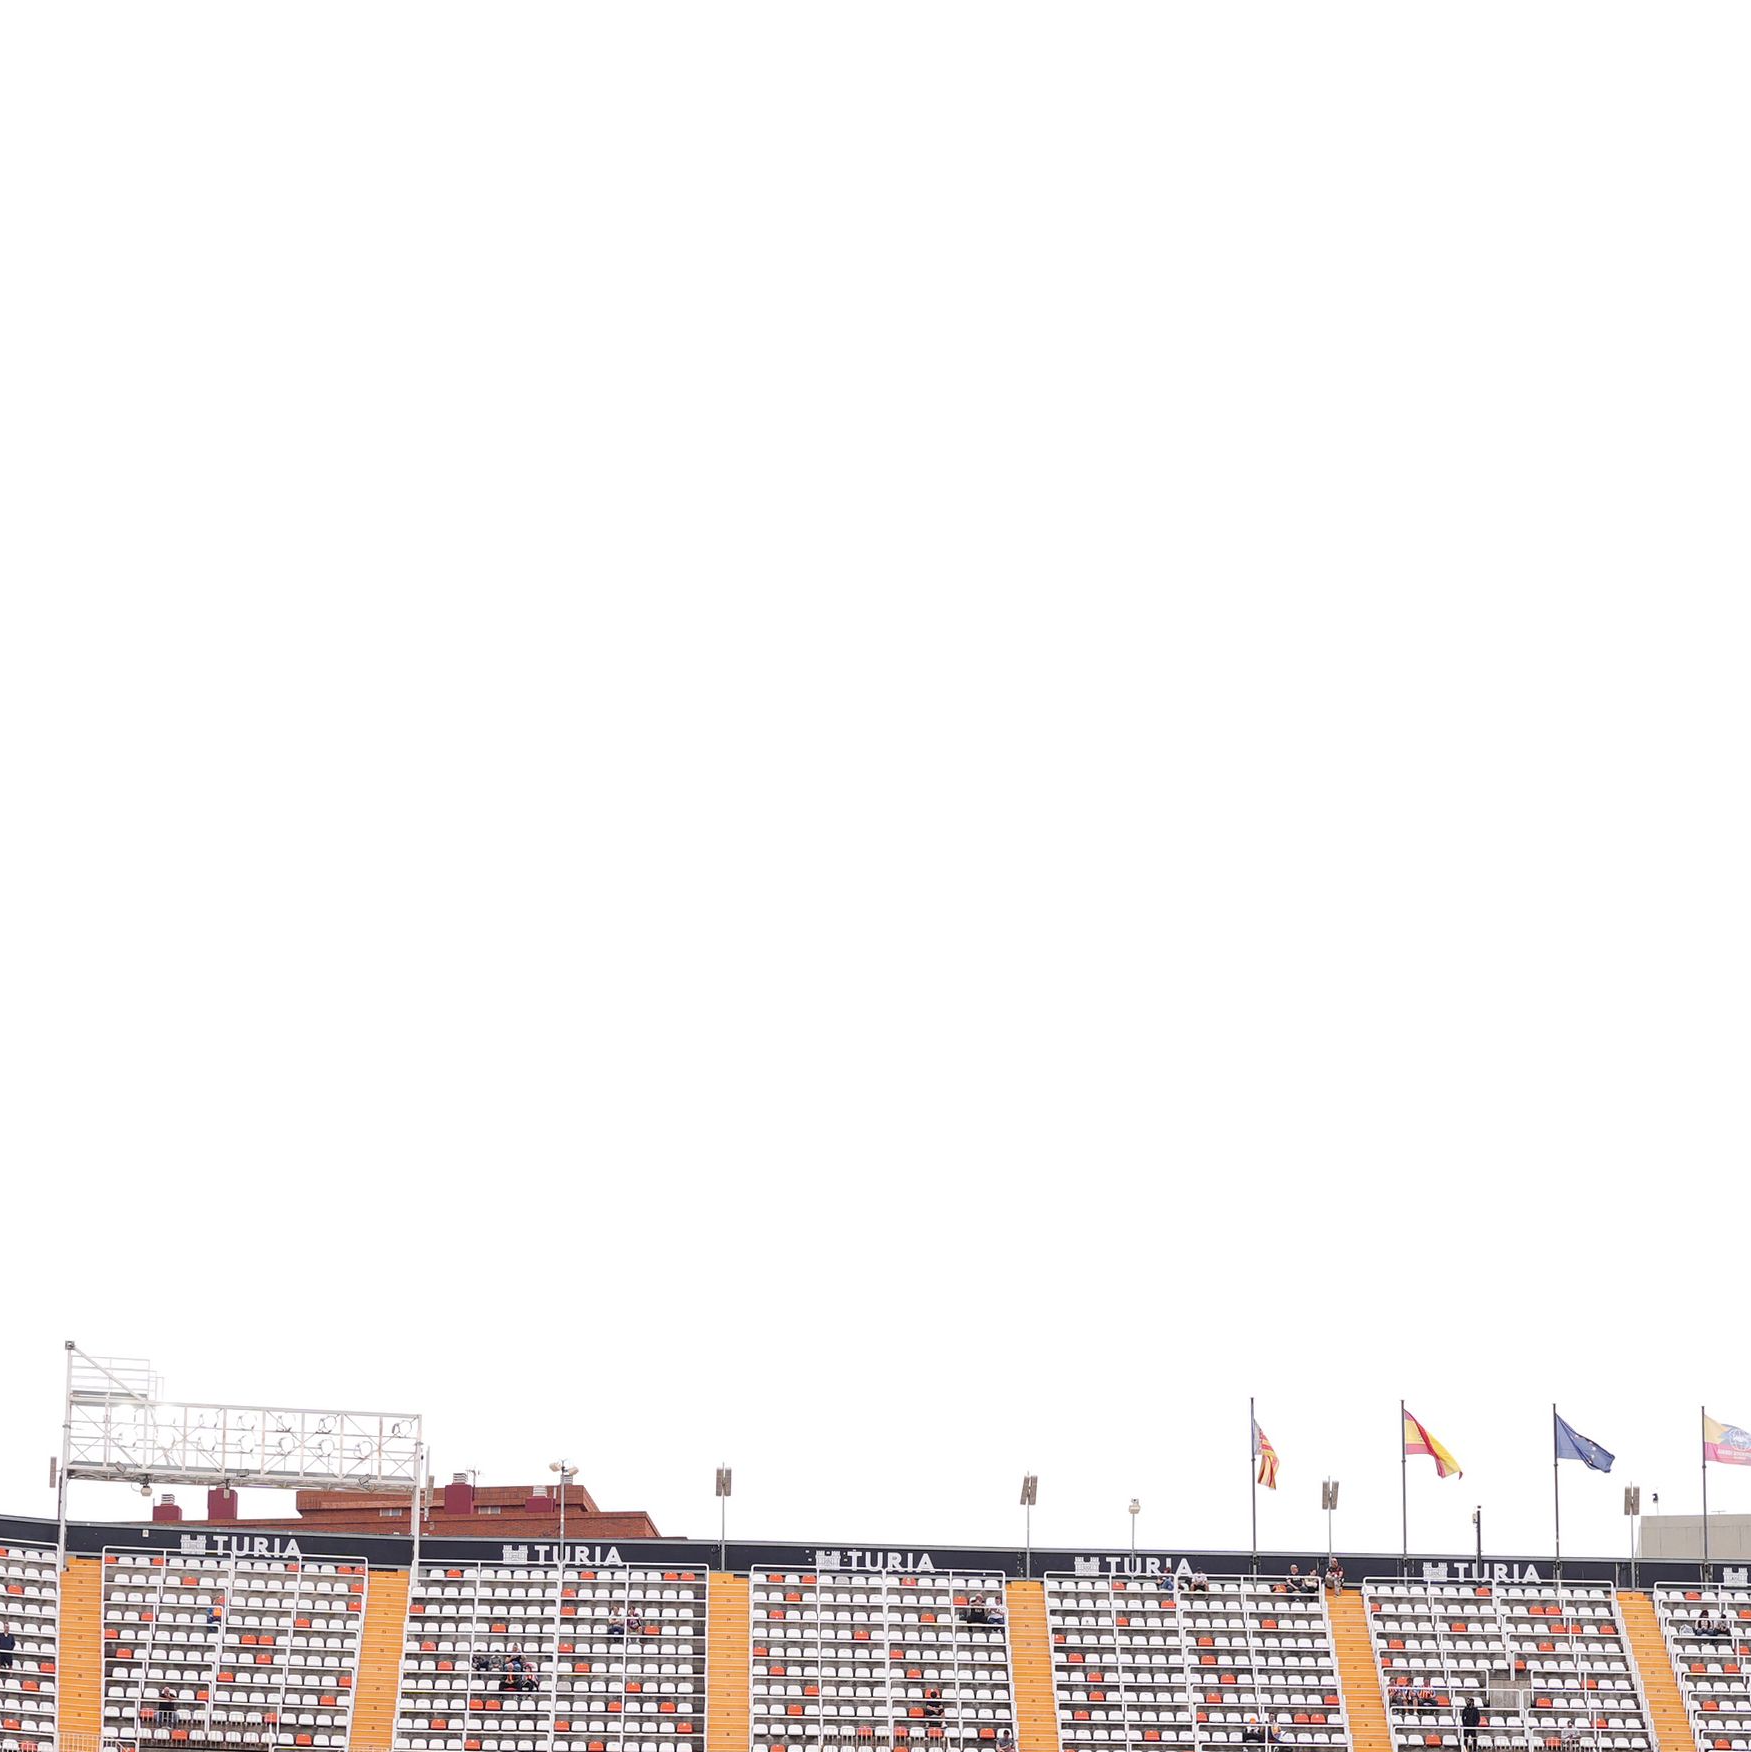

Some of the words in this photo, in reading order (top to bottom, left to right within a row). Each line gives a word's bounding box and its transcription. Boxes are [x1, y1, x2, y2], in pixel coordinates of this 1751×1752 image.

[212, 1534, 301, 1557] TURIA
[533, 1545, 624, 1566] TURIA
[845, 1550, 935, 1573] TURIA
[1106, 1556, 1194, 1579] TURIA
[1453, 1562, 1543, 1585] TURIA
